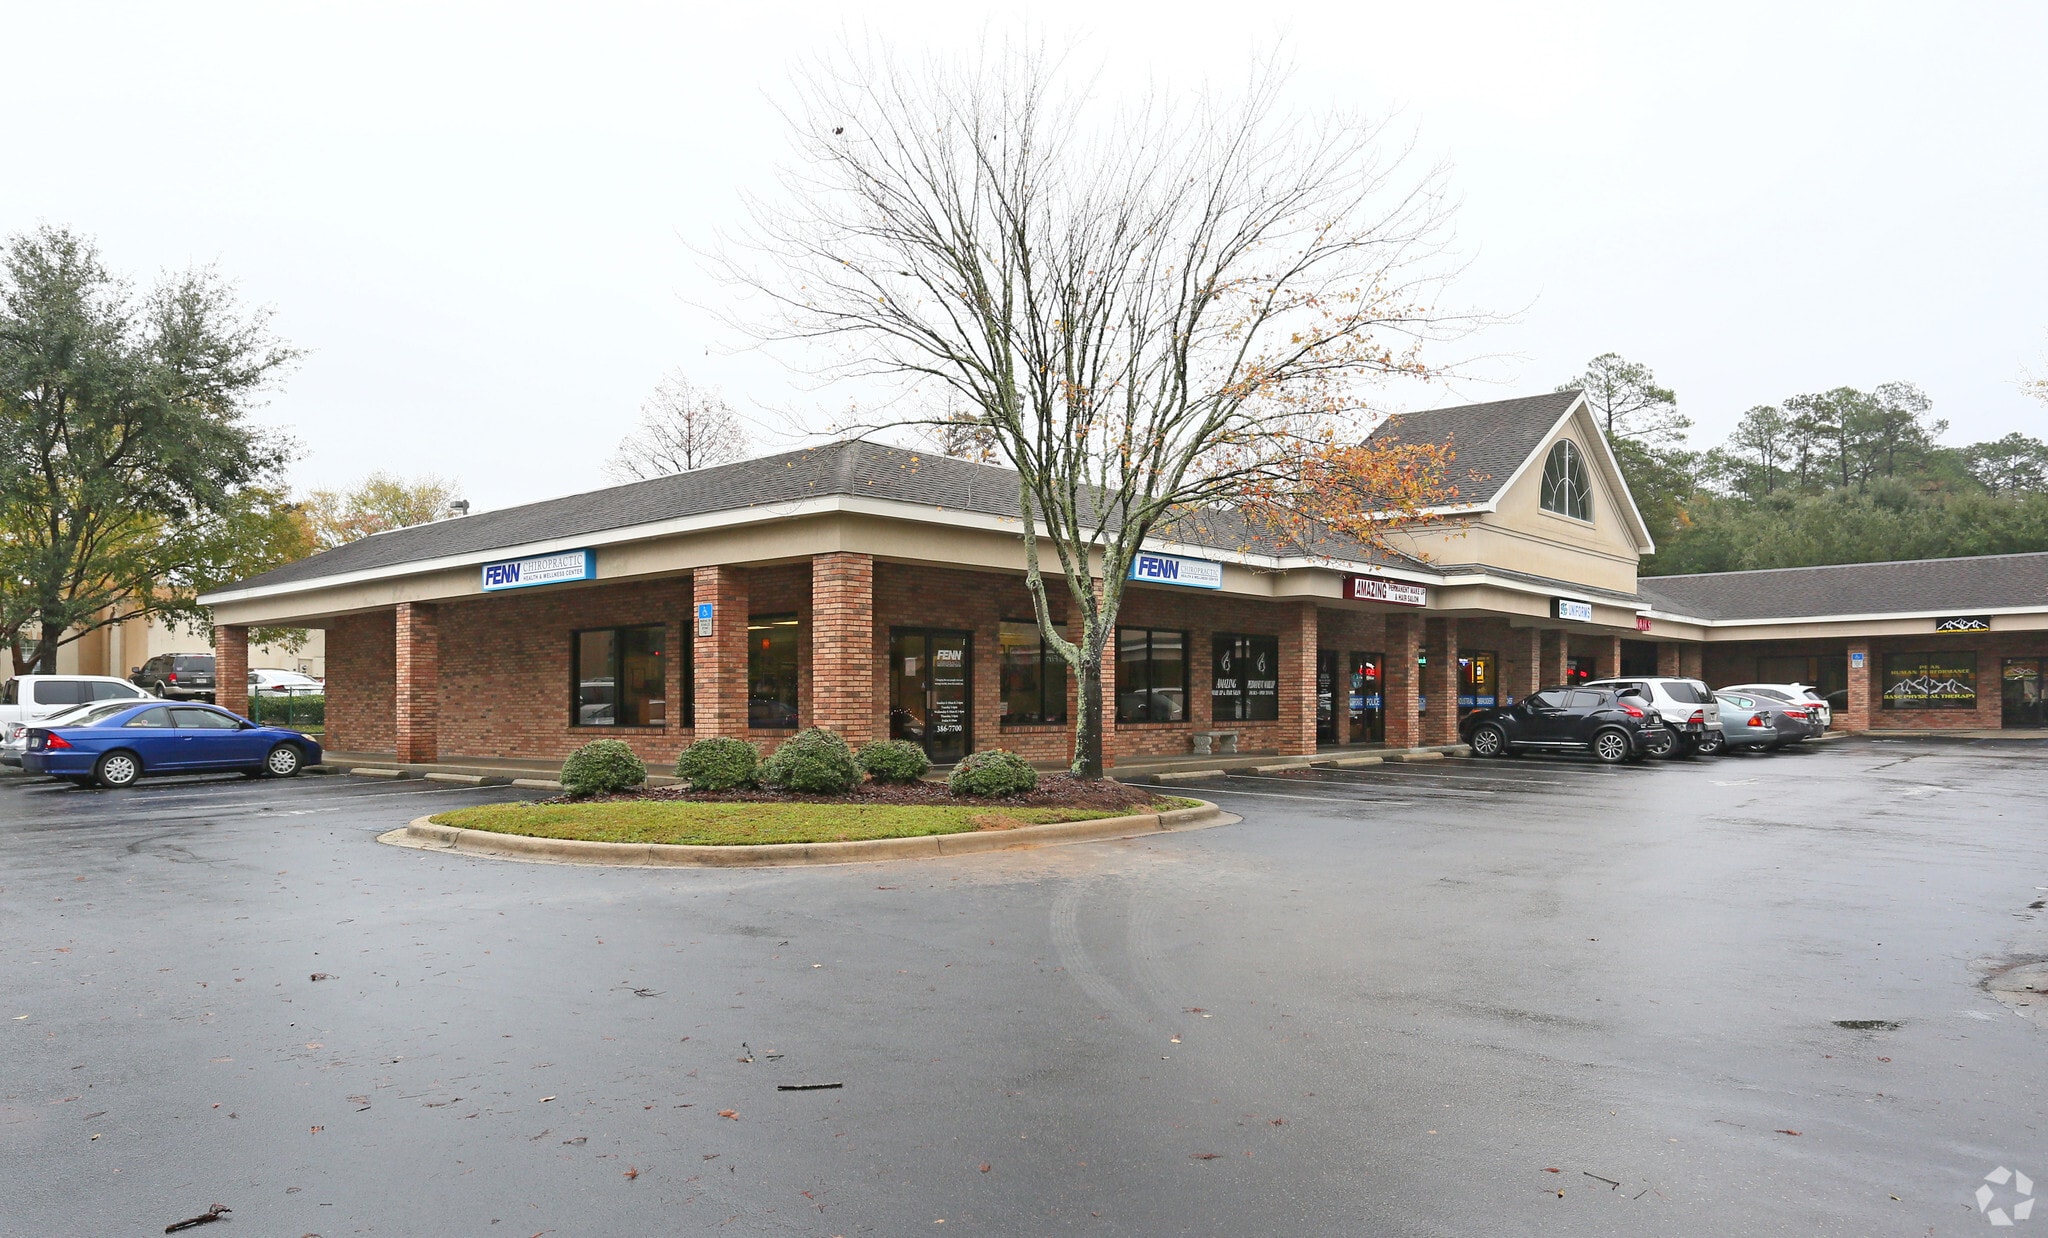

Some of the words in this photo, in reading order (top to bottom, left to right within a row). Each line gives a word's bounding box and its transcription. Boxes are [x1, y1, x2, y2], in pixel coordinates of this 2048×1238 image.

[523, 554, 583, 572] CHIROPRACTIC
[1138, 556, 1180, 580] FENN
[486, 563, 521, 585] FENN
[543, 570, 565, 579] WELLNESS
[566, 568, 583, 576] CENTER
[1180, 565, 1219, 577] CHIROPRACTIC
[1355, 580, 1387, 599] AMAZING
[1388, 583, 1410, 594] PERMANENT
[1568, 604, 1591, 619] UNIFORMS
[937, 649, 962, 661] FENN
[1366, 697, 1380, 706] POLICE
